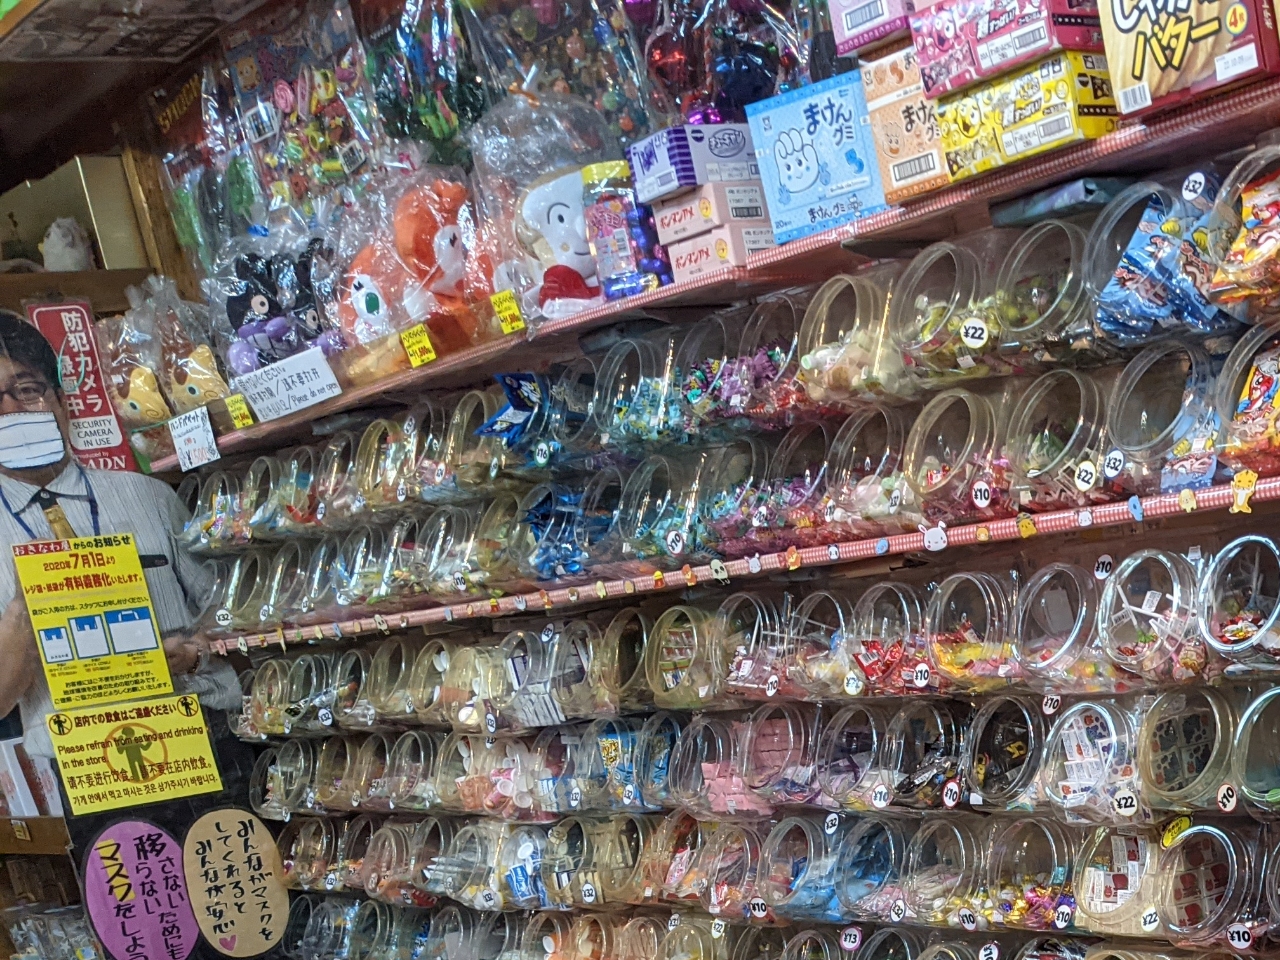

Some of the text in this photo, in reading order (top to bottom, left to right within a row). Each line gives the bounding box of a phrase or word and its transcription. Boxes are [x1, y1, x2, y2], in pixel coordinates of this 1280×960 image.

[963, 326, 985, 341] ¥22
[72, 419, 113, 430] SECURITY
[77, 428, 113, 439] CAMERA
[83, 437, 112, 448] IN USE
[1104, 456, 1123, 472] ¥32
[973, 487, 990, 502] ¥10
[1095, 558, 1112, 574] ¥10
[58, 726, 204, 755] Please refrain from eating and drinking
[62, 760, 69, 769] in
[72, 757, 84, 768] the
[1116, 795, 1136, 811] ¥22
[1229, 929, 1251, 944] ¥10
